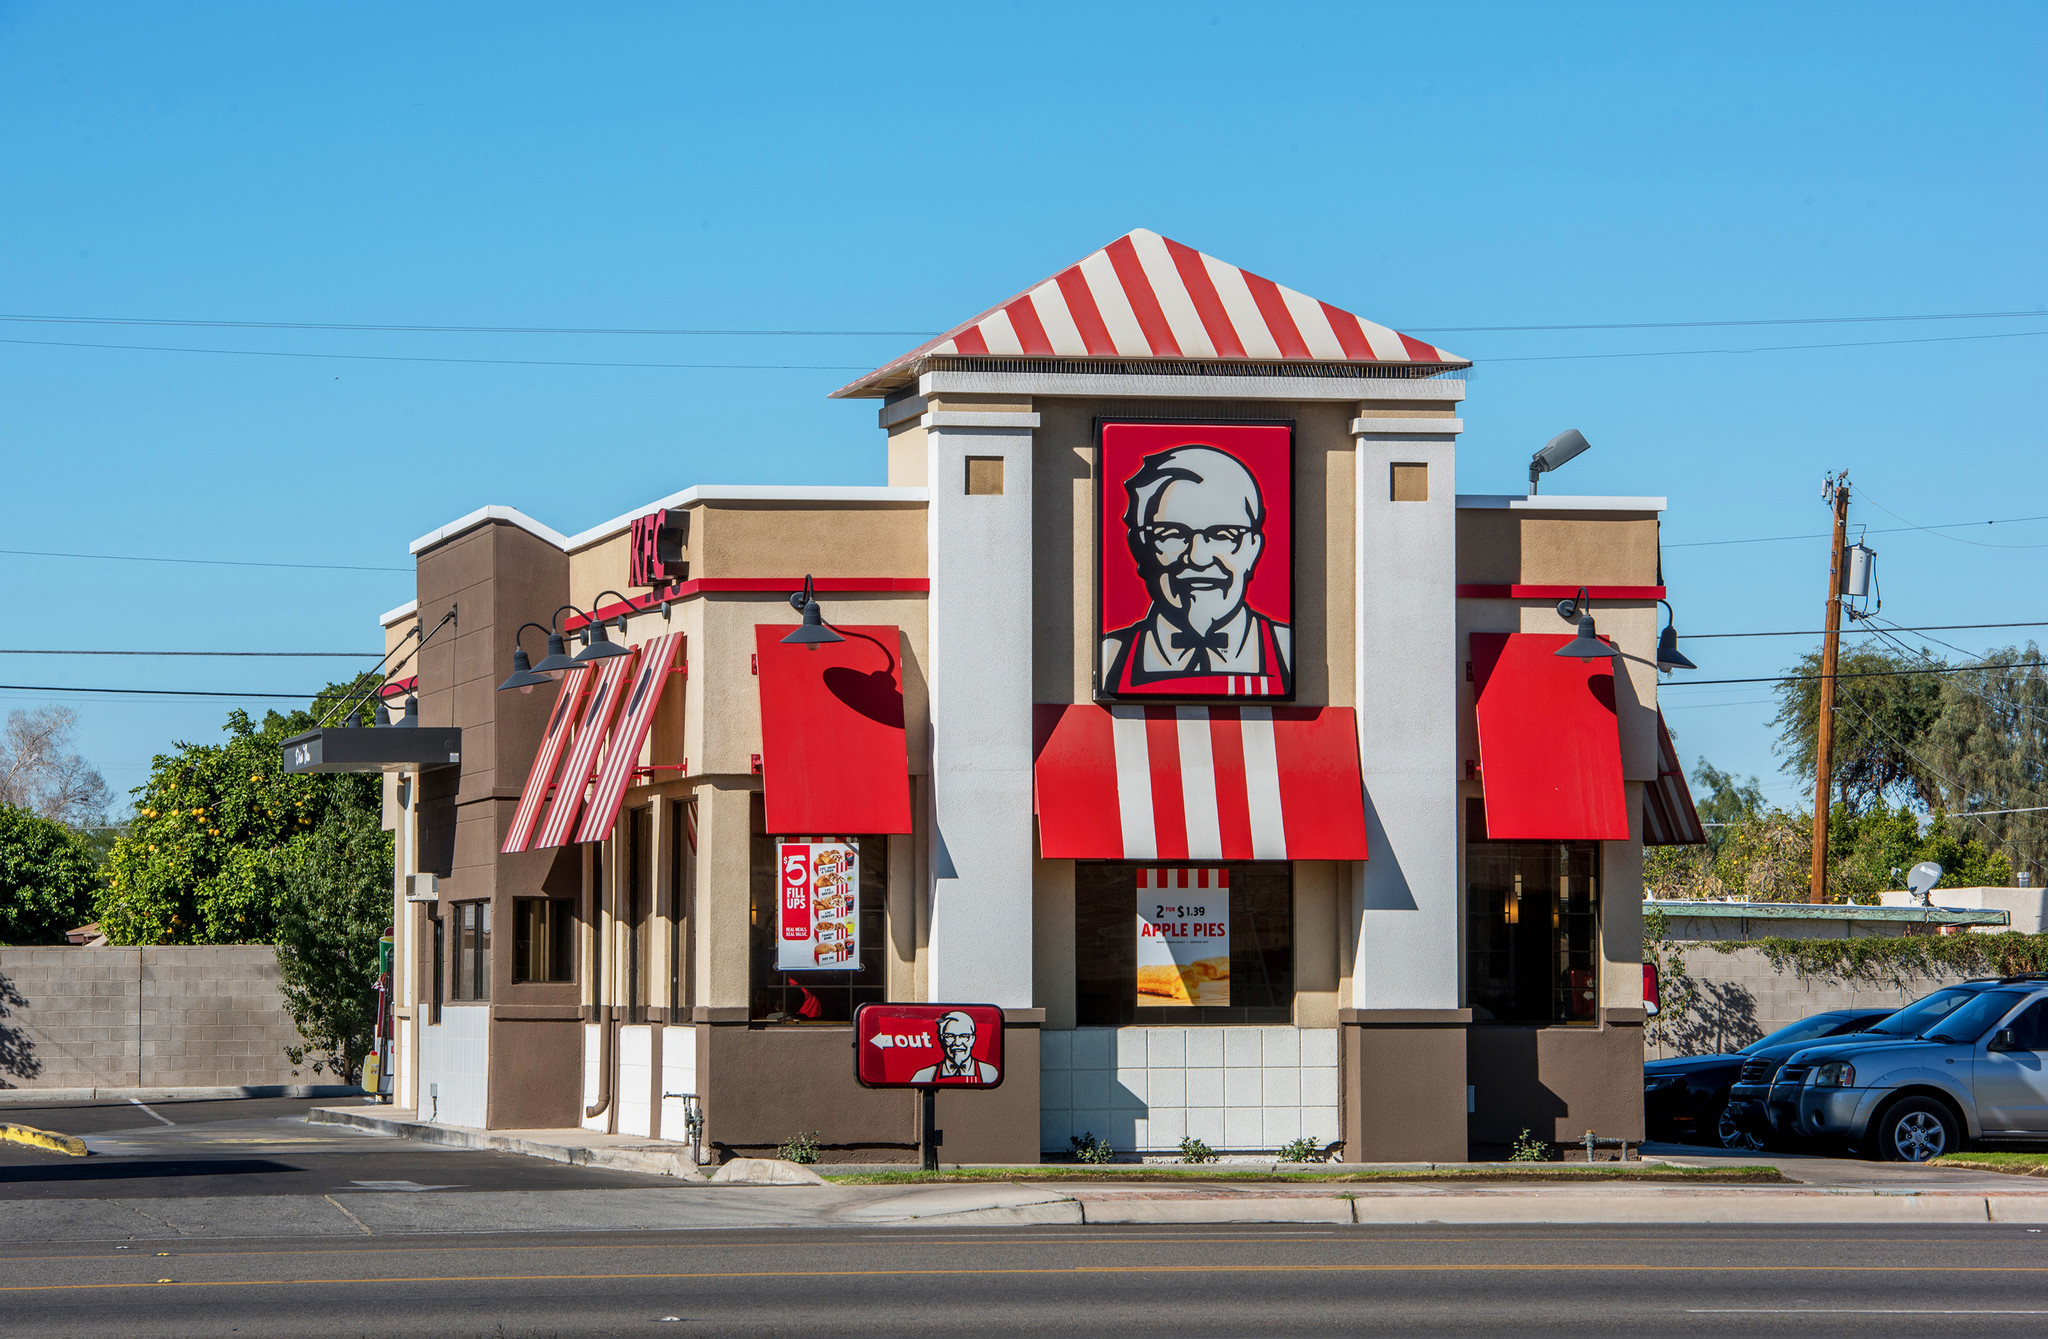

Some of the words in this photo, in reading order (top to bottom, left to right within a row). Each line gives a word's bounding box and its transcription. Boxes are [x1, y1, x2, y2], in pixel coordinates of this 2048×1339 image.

[628, 508, 666, 587] KFC
[783, 855, 807, 886] $5
[786, 887, 806, 898] FILL
[786, 898, 806, 909] UPS
[1156, 905, 1165, 918] 2
[1141, 923, 1189, 937] APPLE
[1193, 923, 1226, 937] PIES
[894, 1032, 933, 1048] out
